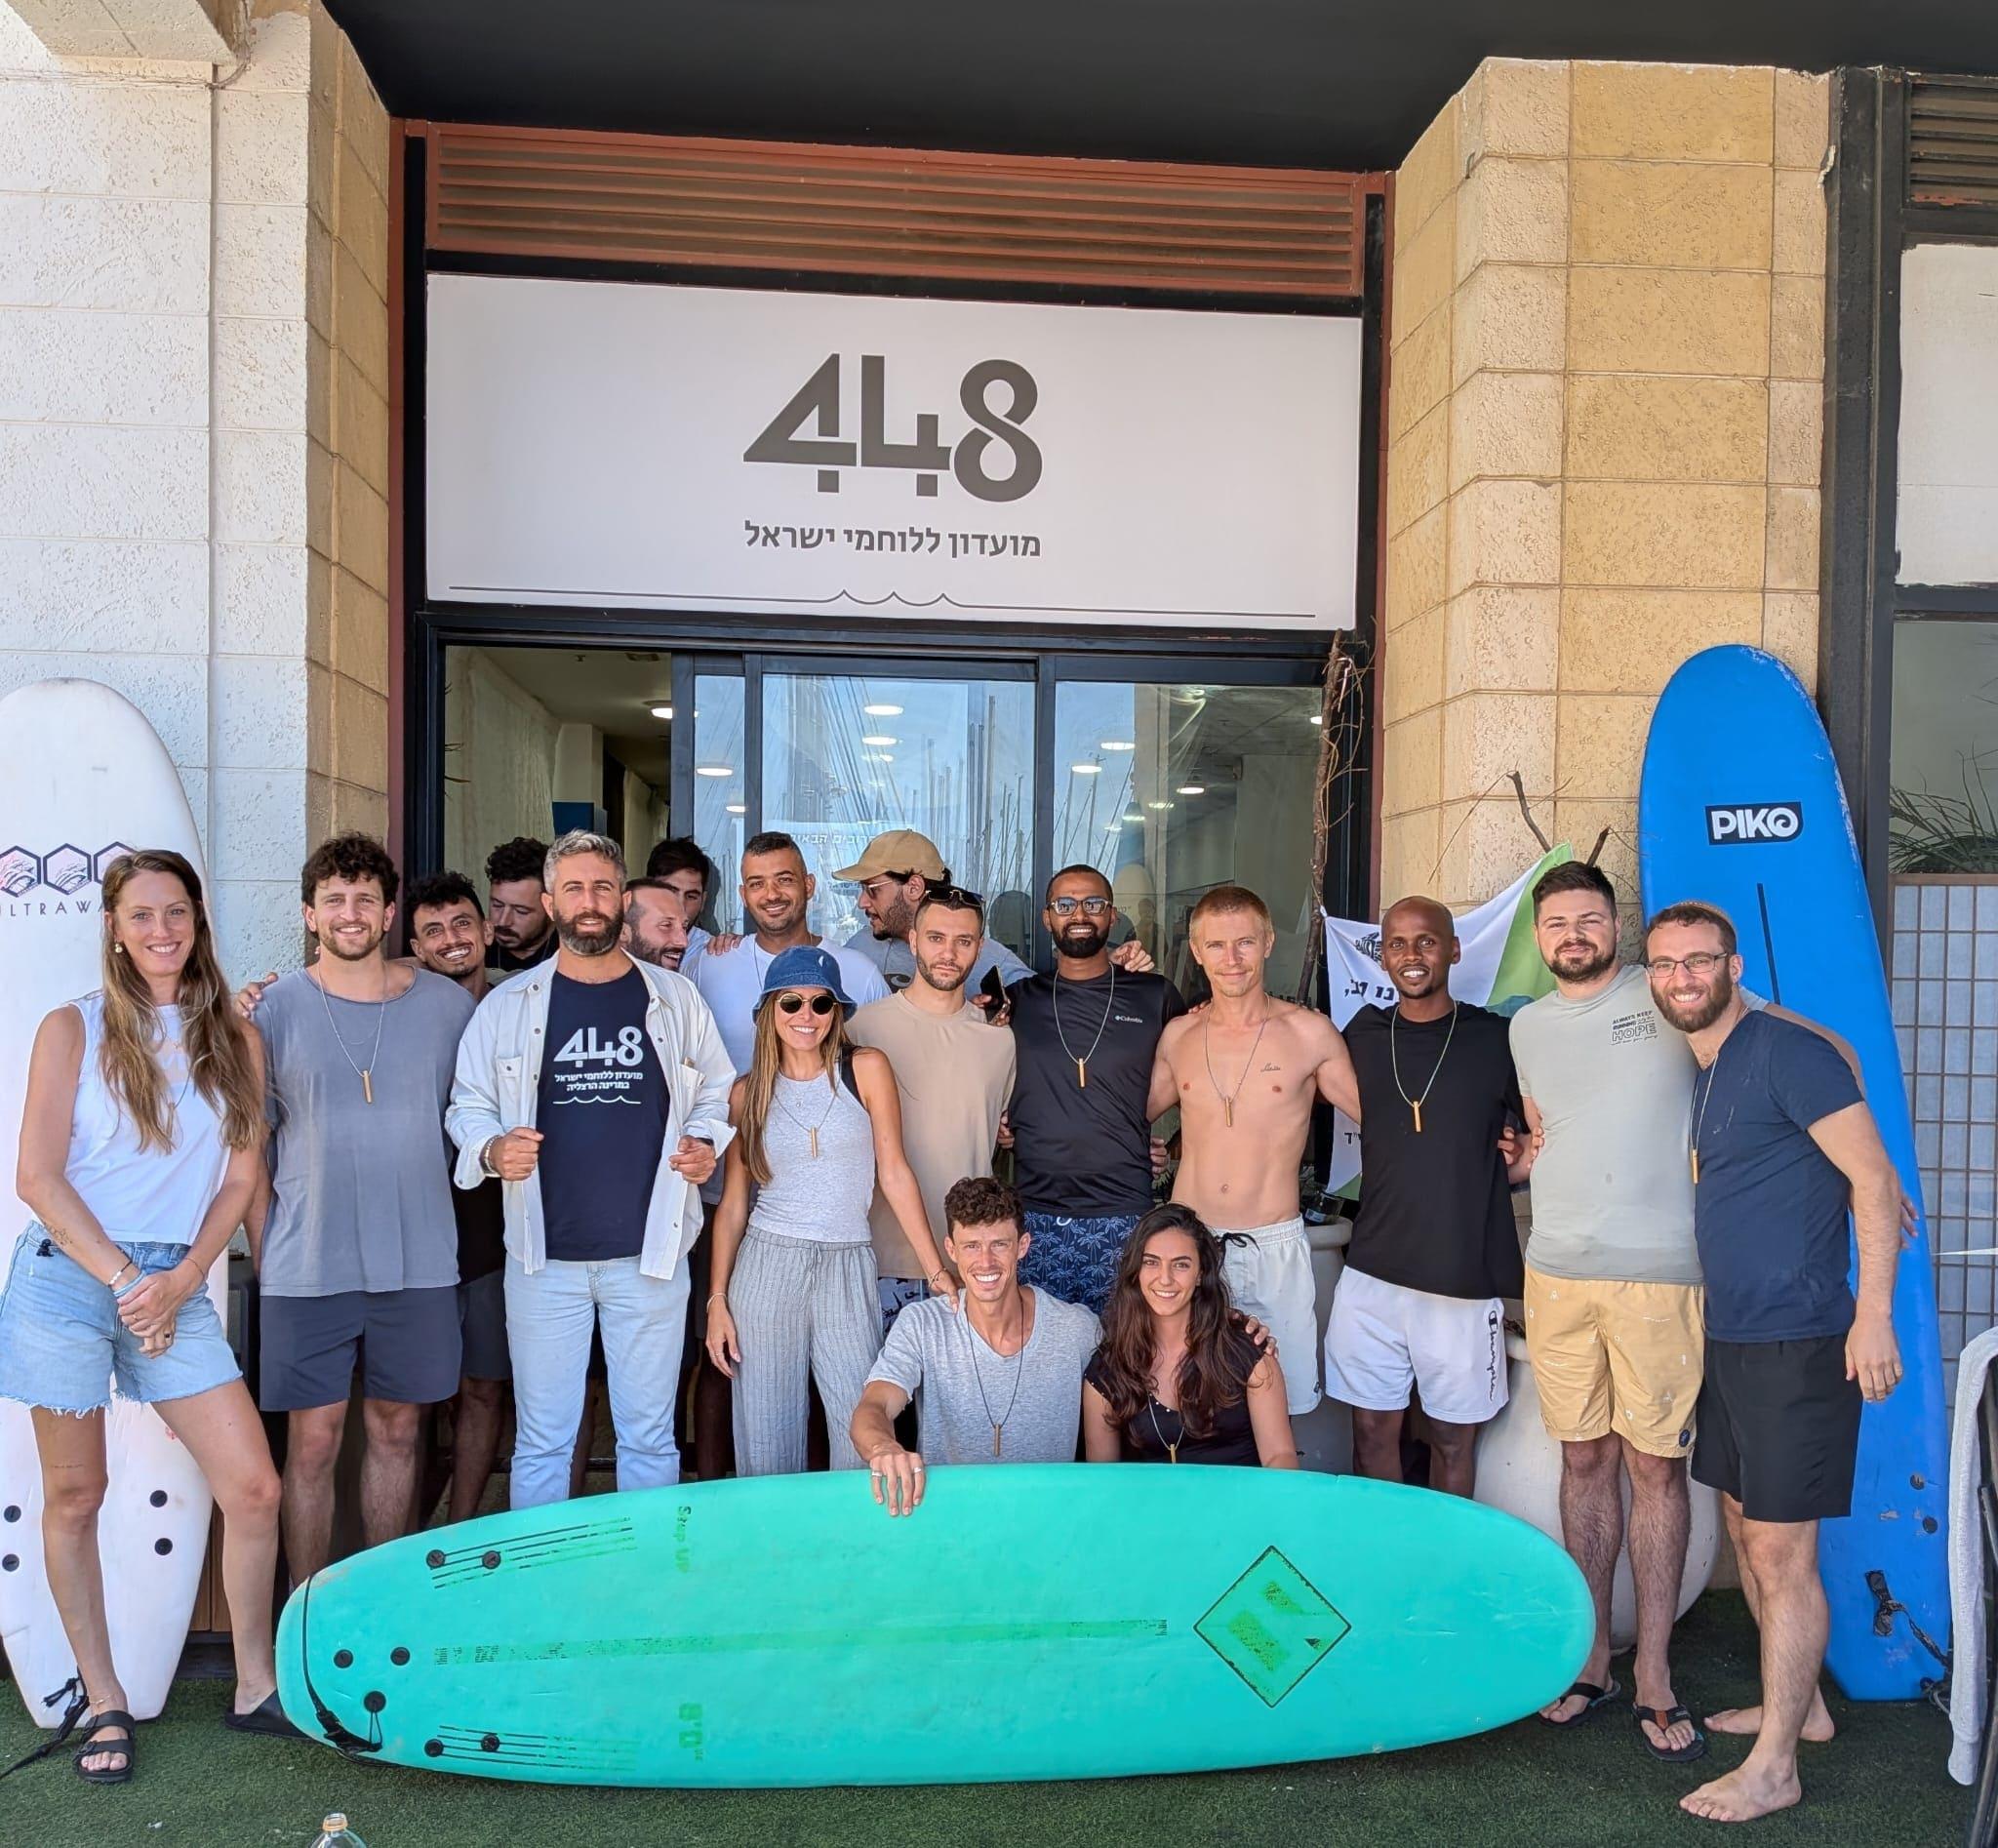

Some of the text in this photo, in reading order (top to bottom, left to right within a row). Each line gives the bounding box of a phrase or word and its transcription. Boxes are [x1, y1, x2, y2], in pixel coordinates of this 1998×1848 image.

[742, 352, 1043, 503] 448
[743, 519, 1041, 559] מועדון ללוחמי ישראל
[1710, 806, 1799, 840] PIKO
[1612, 1023, 1657, 1041] HOPE
[1613, 1015, 1636, 1024] ALWAYS
[553, 1025, 644, 1068] 448
[554, 1070, 644, 1082] מועדון ללוחמי ישראל
[566, 1081, 630, 1092] במרינה הרצליה
[1487, 1309, 1498, 1402] Champion
